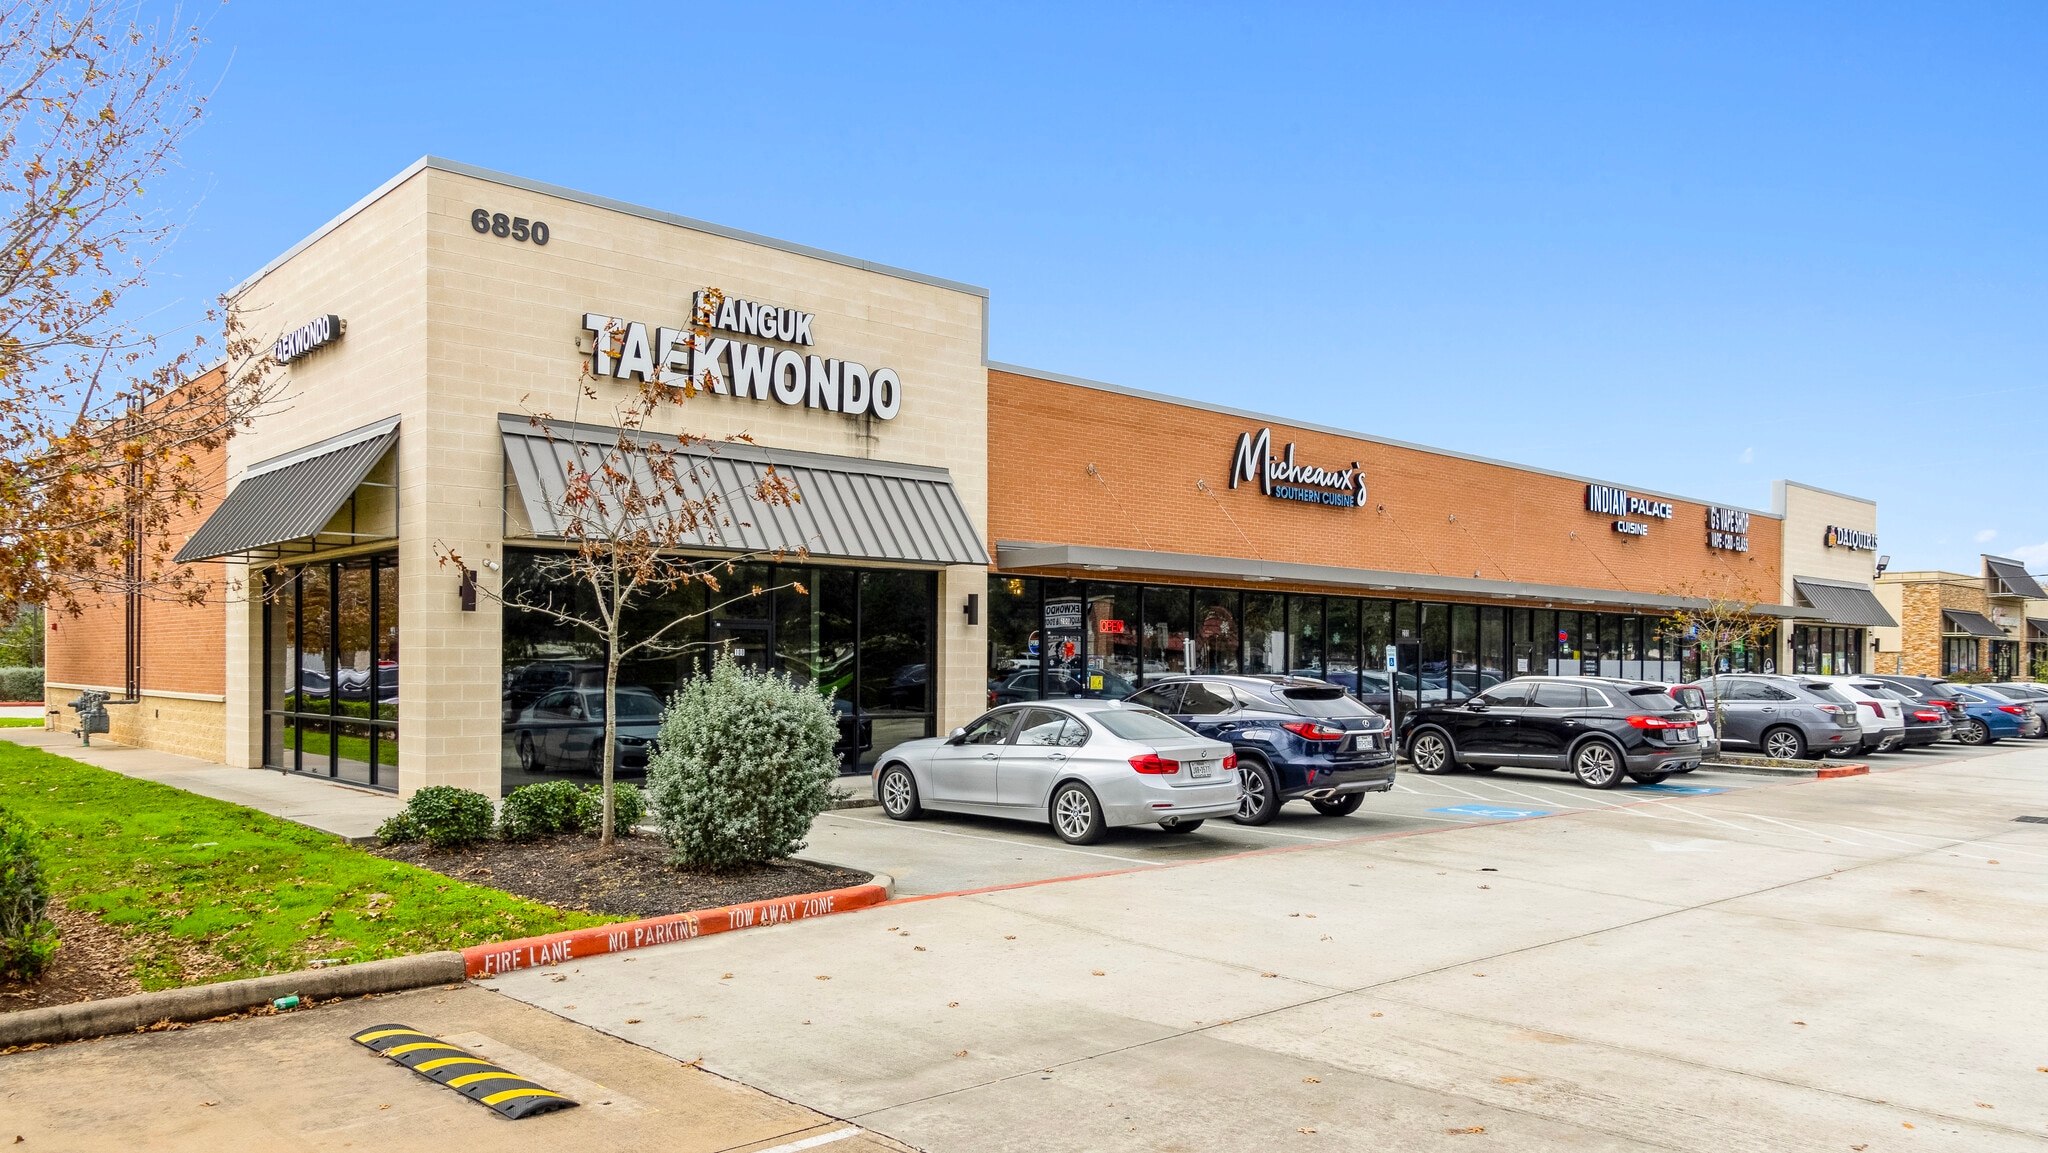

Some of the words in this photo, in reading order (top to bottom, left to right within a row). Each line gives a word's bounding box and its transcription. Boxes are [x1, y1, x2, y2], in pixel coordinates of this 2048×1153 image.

[471, 208, 550, 246] 6850
[693, 289, 815, 346] HANGUK
[583, 313, 901, 420] TAEKWONDO
[1229, 427, 1367, 507] Micheaux's
[1275, 485, 1321, 504] SOUTHERN
[1321, 492, 1355, 508] CUISINE
[1589, 484, 1627, 517] INDIAN
[1630, 497, 1673, 519] PALACE
[1616, 520, 1648, 536] CUISINE
[1720, 508, 1735, 533] VAPE
[1735, 510, 1749, 535] SHOP
[1837, 526, 1878, 551] DAIQUIRIS
[1100, 620, 1124, 633] OPEN
[484, 948, 523, 974] FIRE
[529, 939, 574, 967] LANE
[609, 931, 629, 952] NO
[635, 916, 699, 946] PARKING
[728, 907, 754, 929] TOW
[761, 901, 797, 923] AWAY
